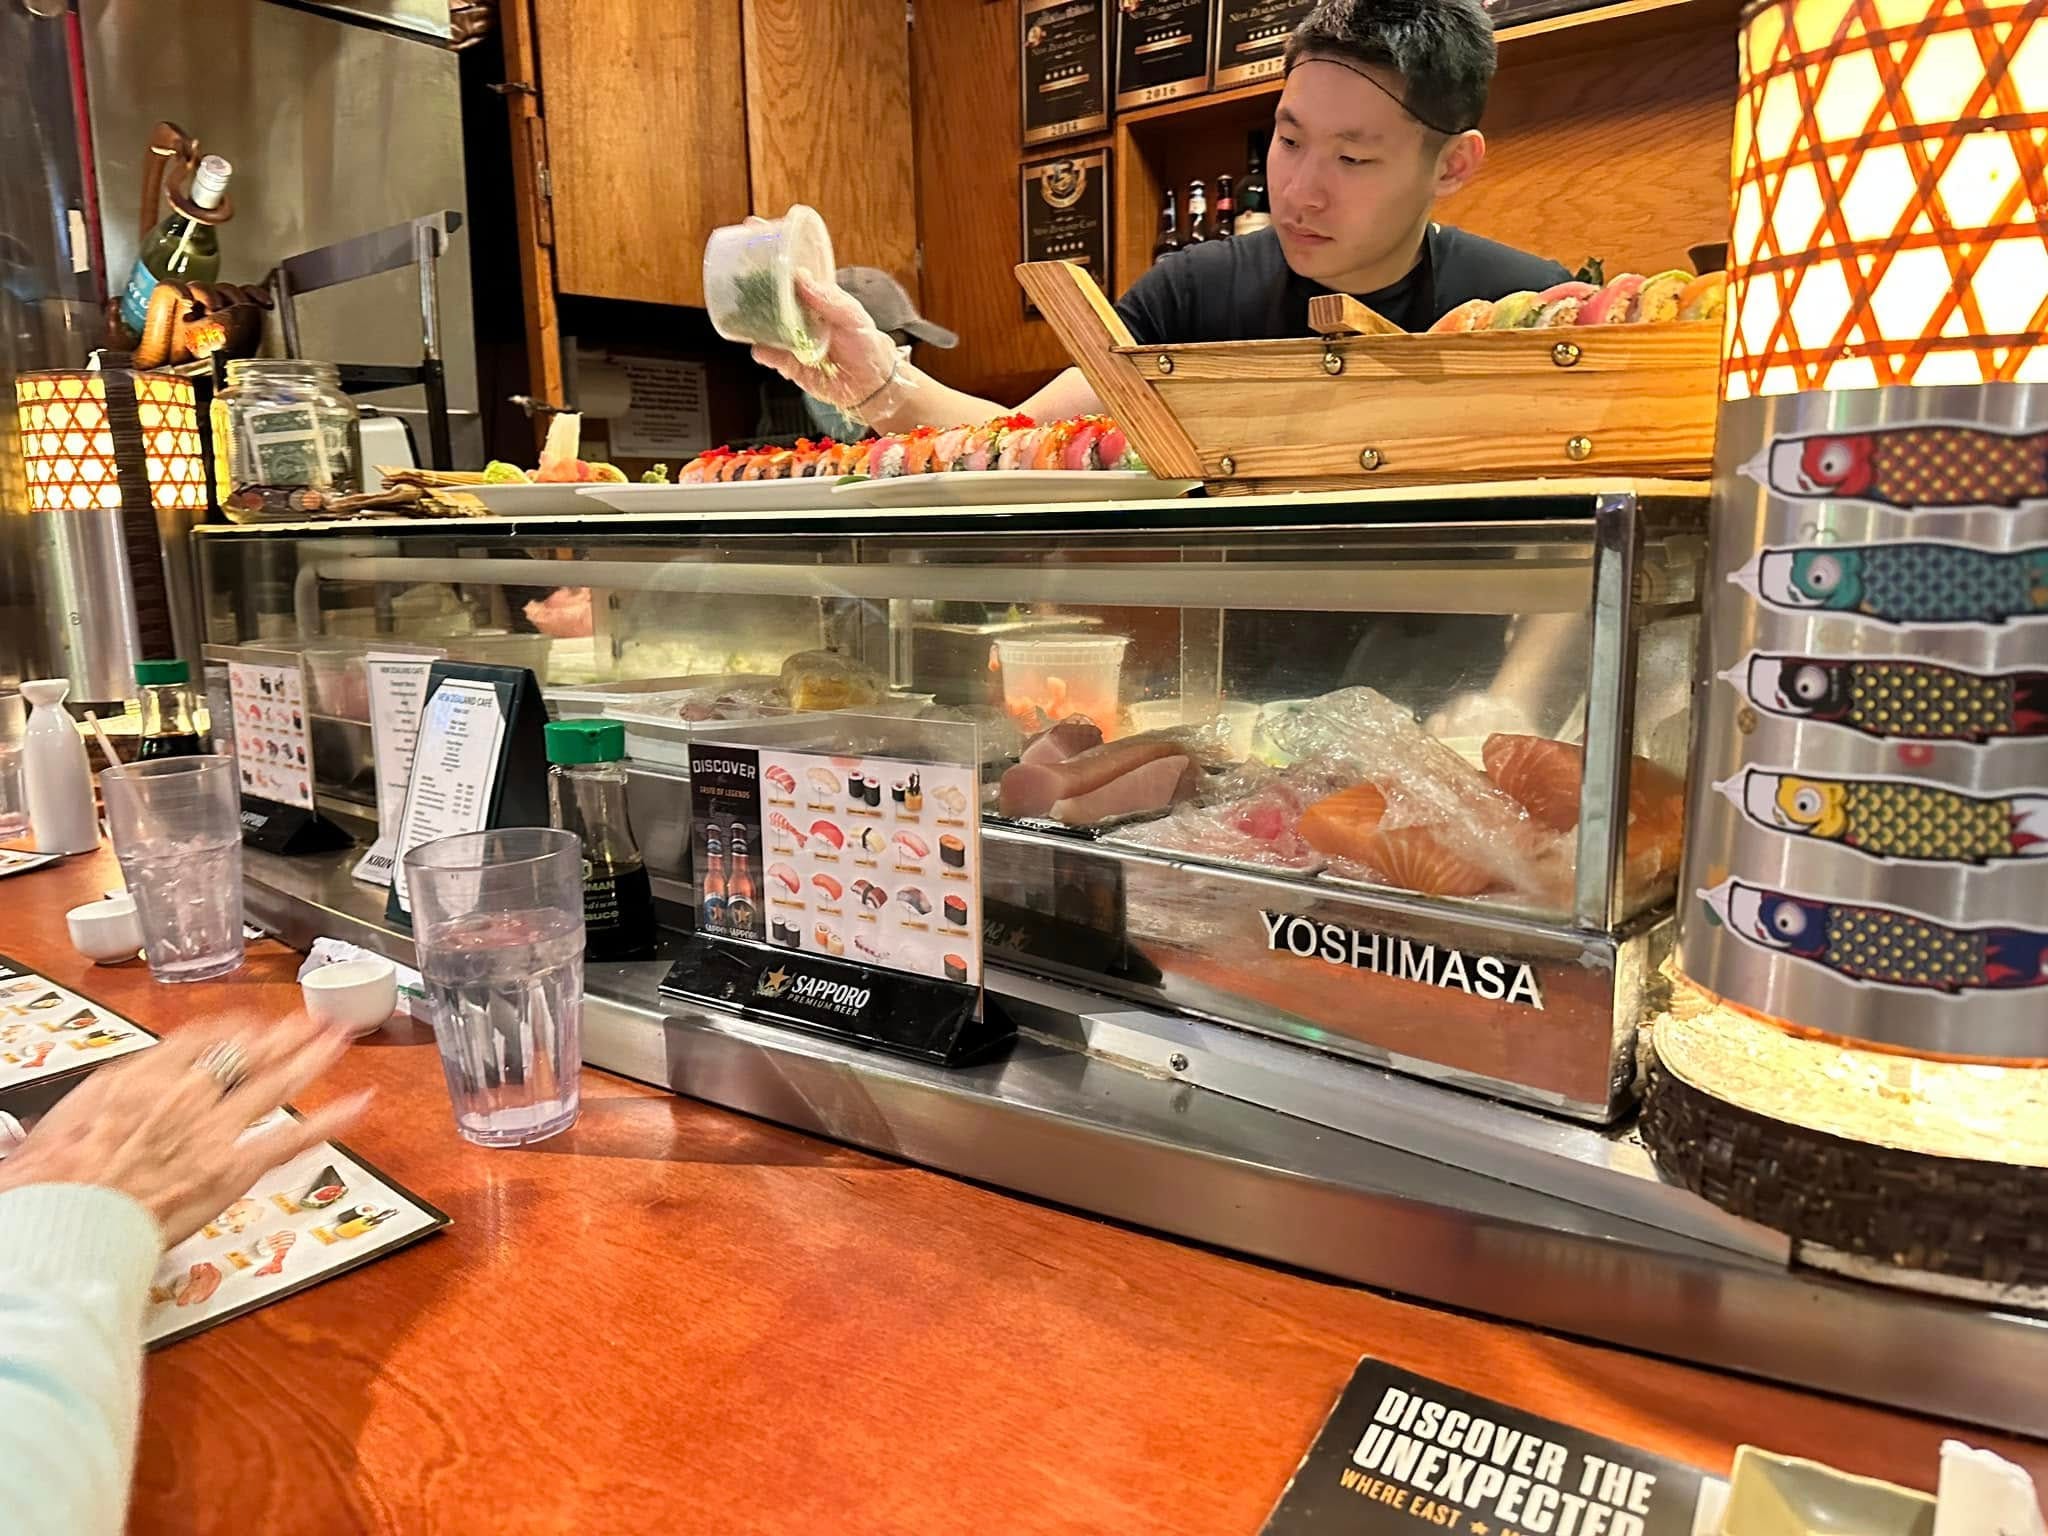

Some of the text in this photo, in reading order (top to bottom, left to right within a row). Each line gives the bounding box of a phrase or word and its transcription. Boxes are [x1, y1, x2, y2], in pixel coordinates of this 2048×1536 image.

[1248, 59, 1283, 76] 2017
[1145, 86, 1177, 101] 2016
[1050, 122, 1079, 136] 2014
[692, 759, 756, 780] DISCOVER
[366, 854, 395, 869] KIRIN
[1258, 909, 1544, 1011] YOSHIMASA
[792, 975, 871, 1009] SAPPORO
[786, 993, 860, 1017] PREMIUM BEER
[1373, 1385, 1657, 1515] DISCOVER THE
[1352, 1423, 1645, 1536] UNEXPECTED
[1340, 1468, 1463, 1529] WHERE EAST
